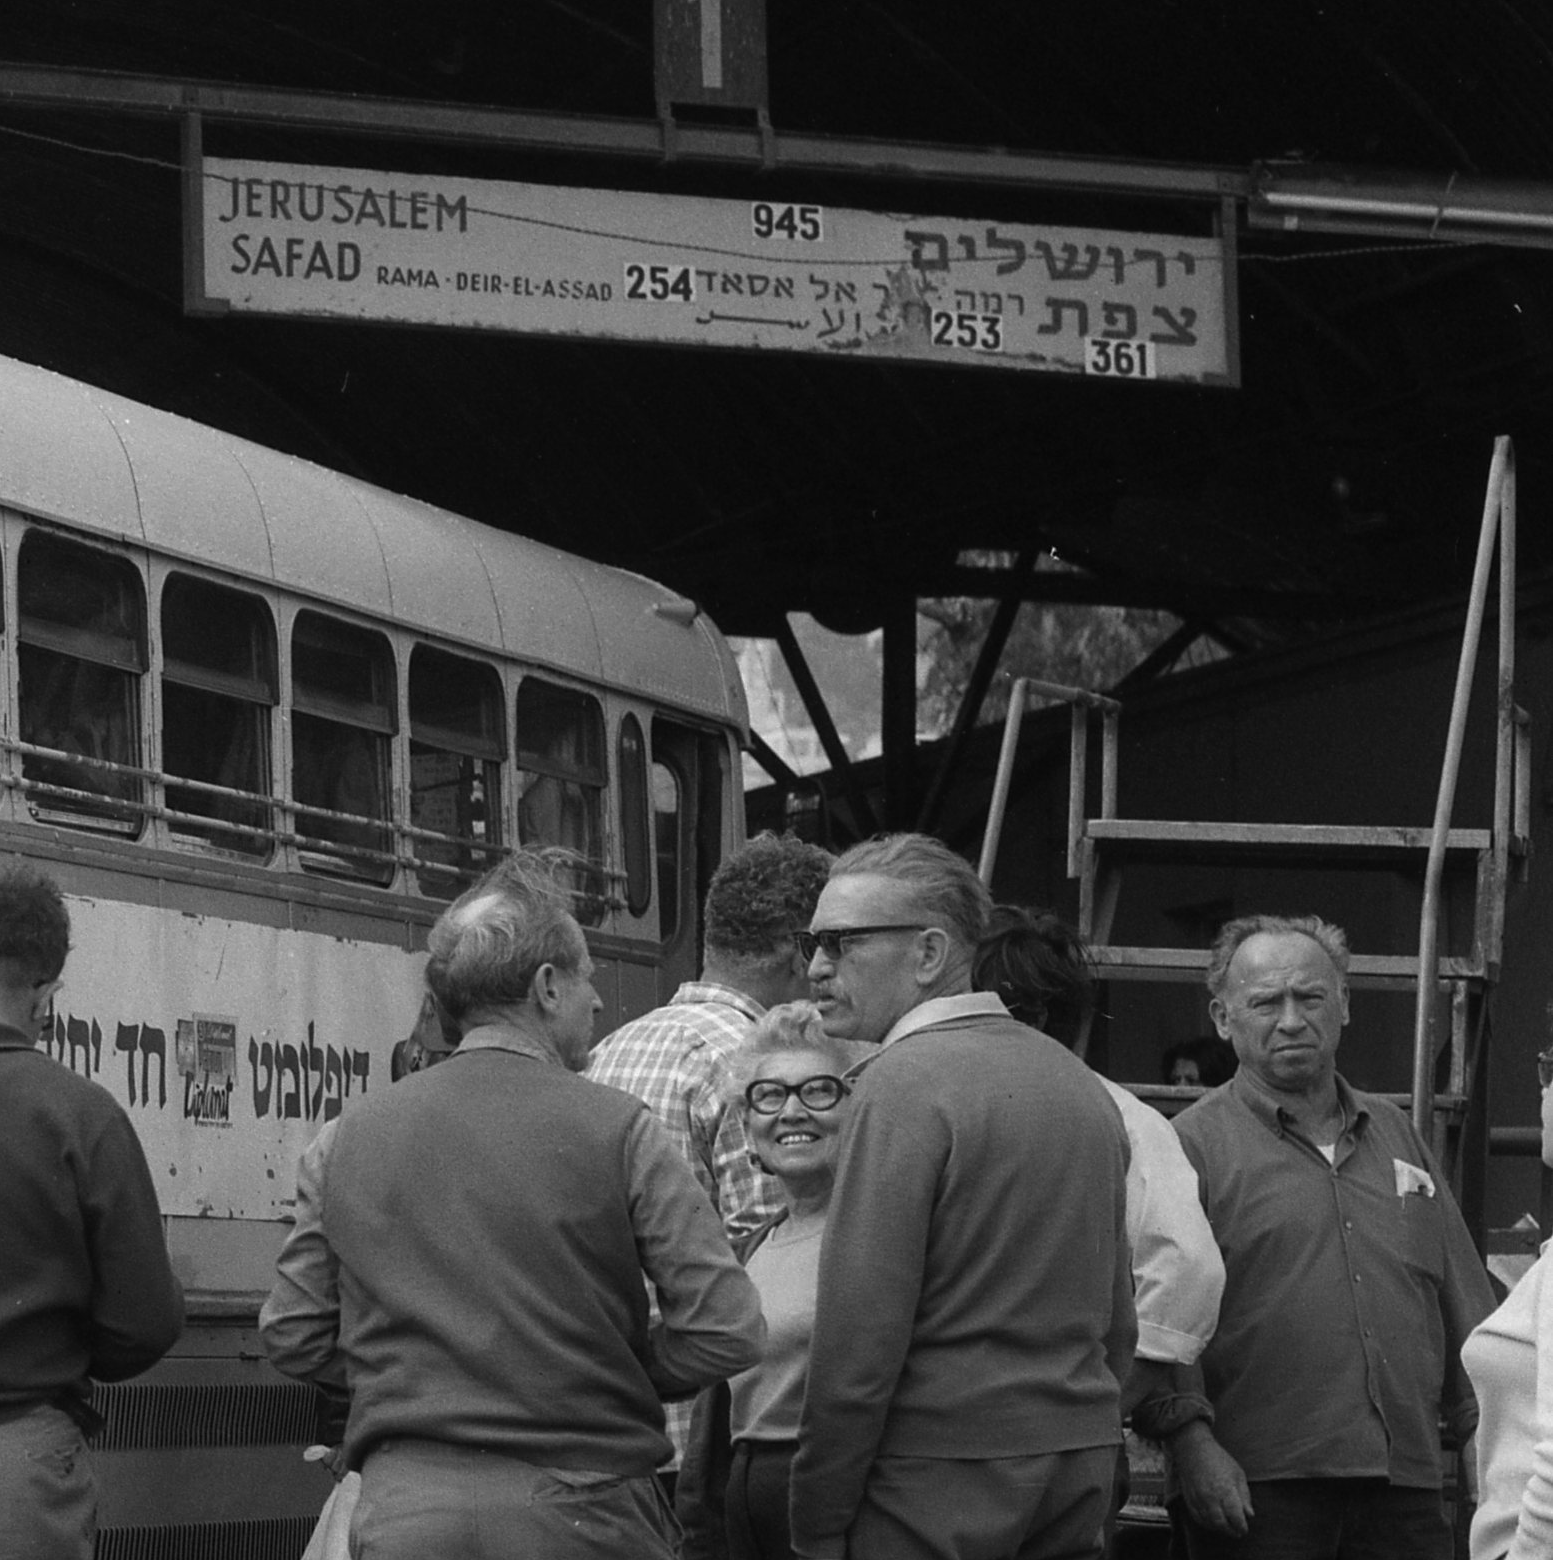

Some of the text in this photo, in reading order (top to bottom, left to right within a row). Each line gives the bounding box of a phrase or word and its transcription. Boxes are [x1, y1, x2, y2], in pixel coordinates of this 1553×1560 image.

[218, 176, 469, 233] JERUSALEM
[753, 204, 821, 240] 945
[230, 233, 363, 283] SAFAD
[904, 227, 1197, 287] ירושלים
[376, 265, 440, 288] RAMA
[456, 271, 613, 302] DEIR-EL-ASSAD
[625, 264, 693, 302] 254
[809, 274, 857, 304] אל
[933, 312, 1002, 350] 253
[1037, 297, 1198, 348] צפת
[1090, 339, 1148, 376] 361
[116, 1020, 167, 1110] חד
[248, 1020, 370, 1123] דיפלומט
